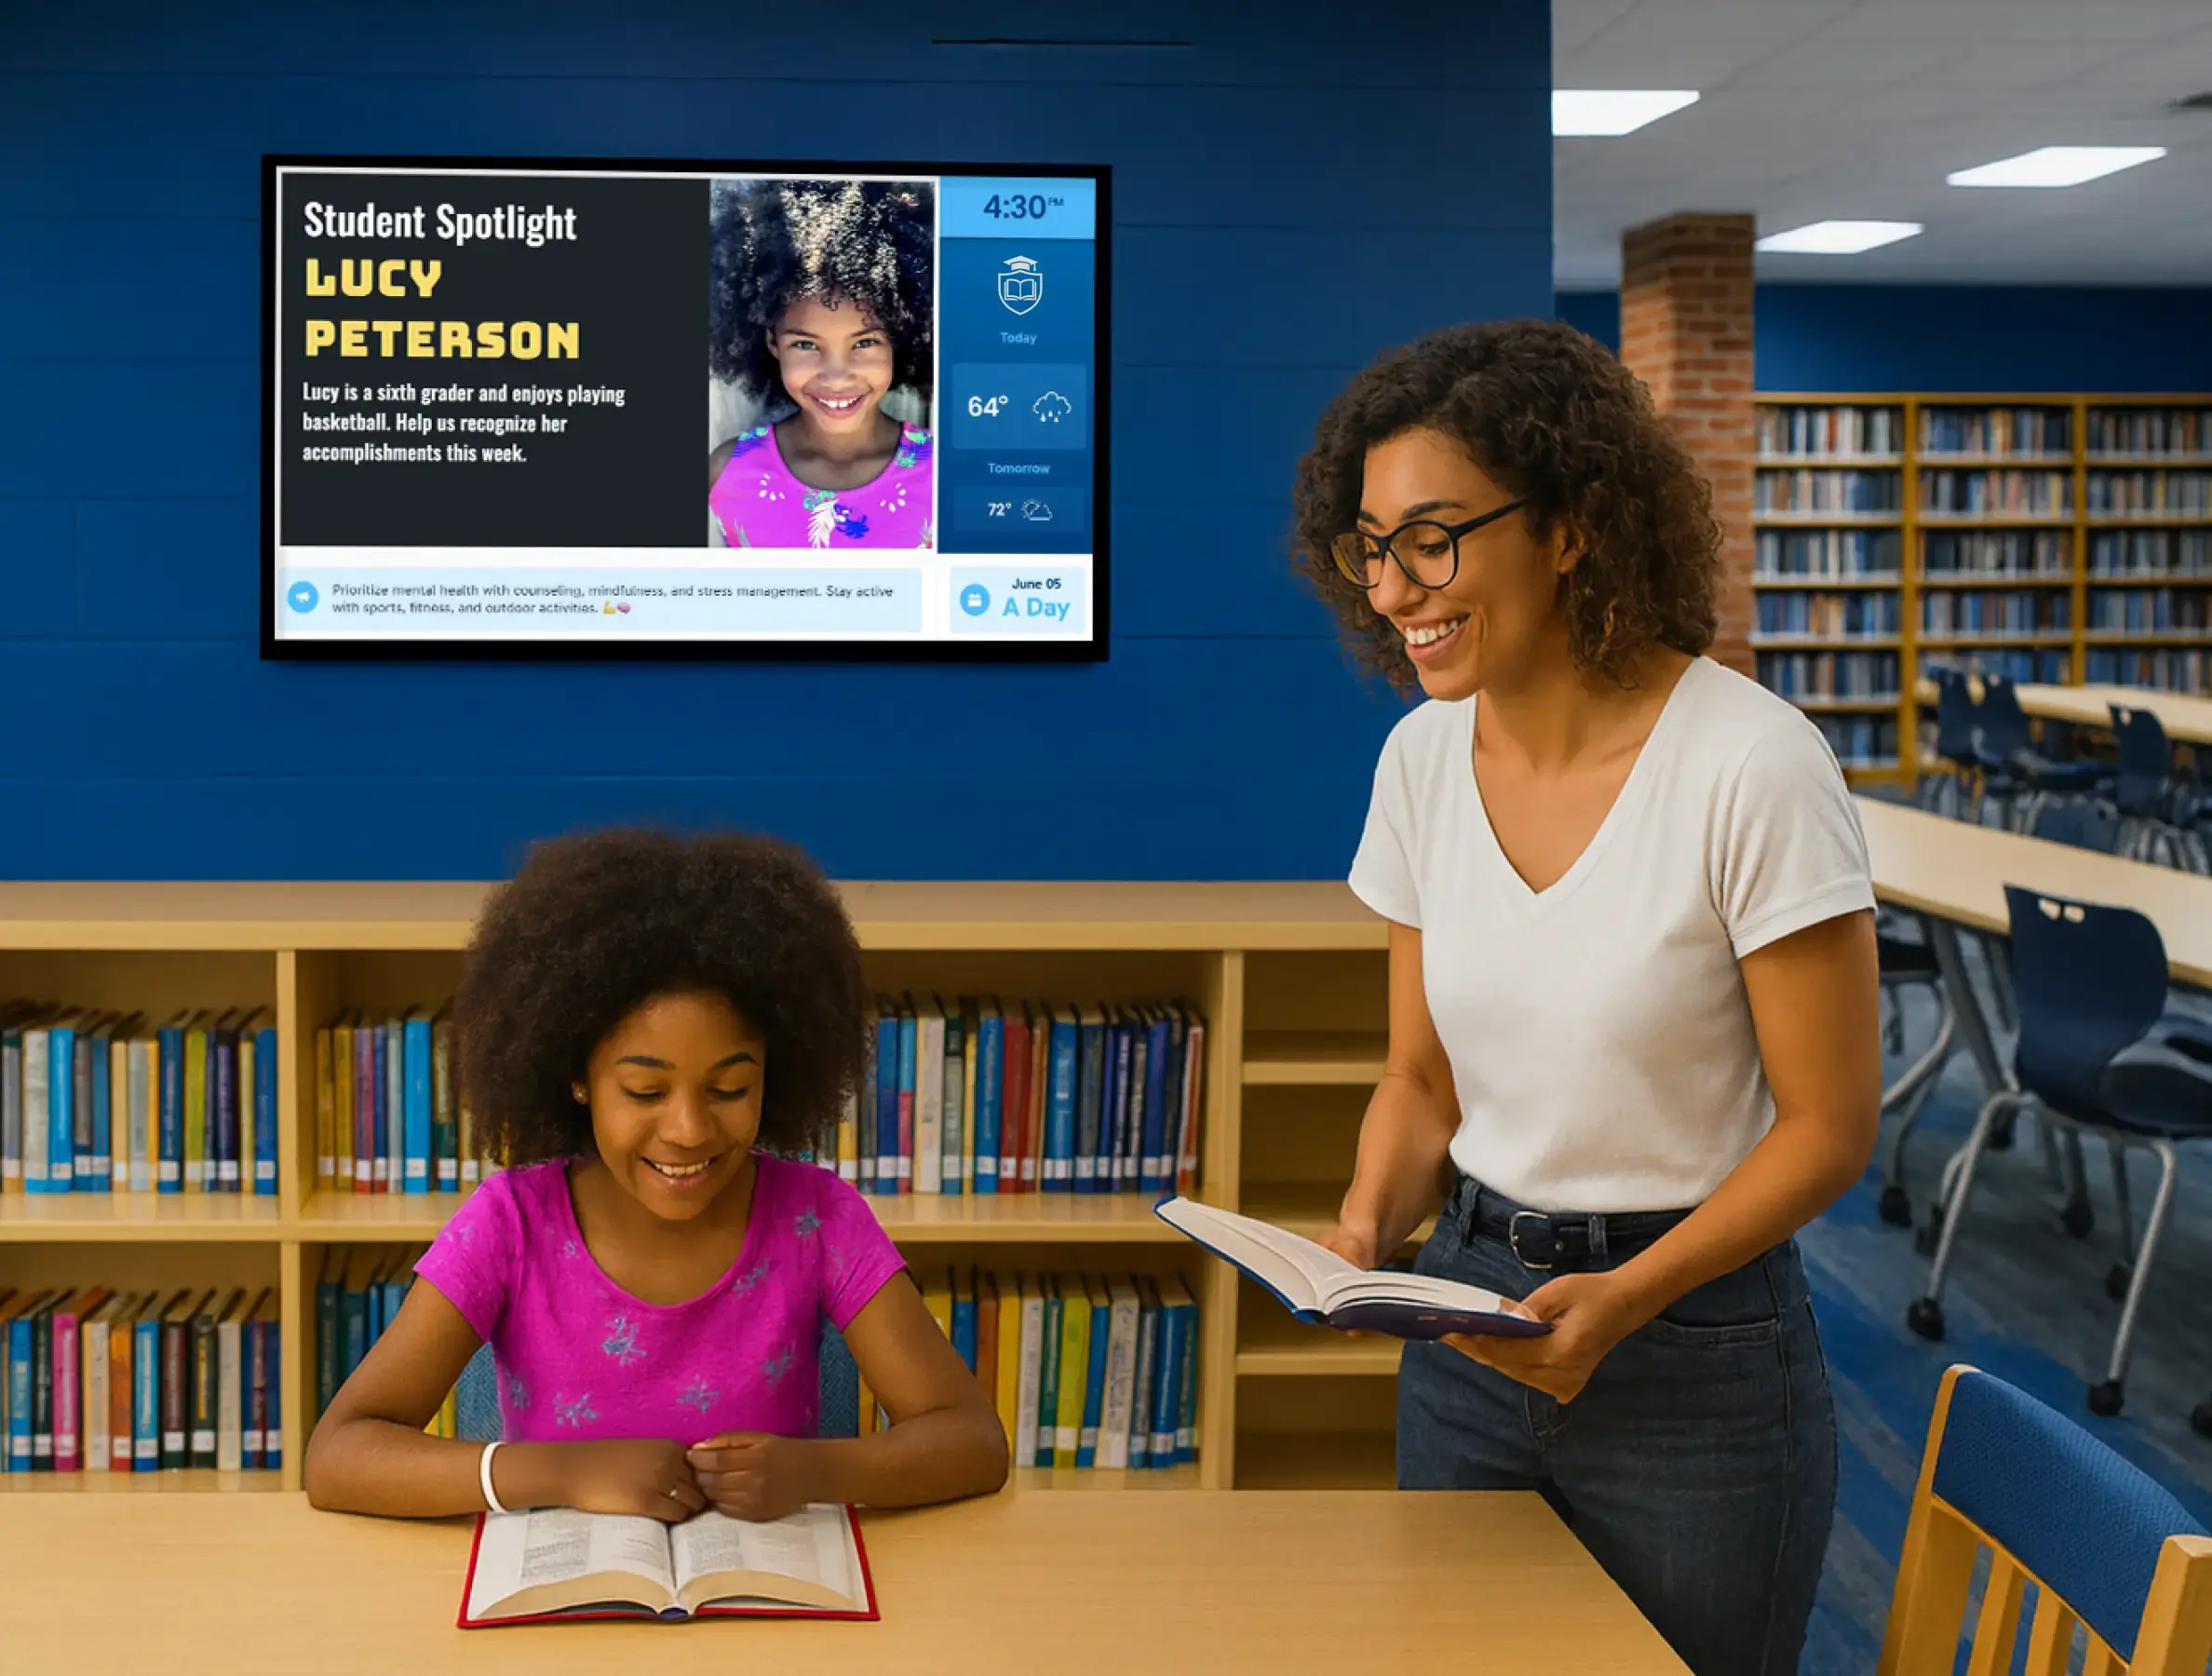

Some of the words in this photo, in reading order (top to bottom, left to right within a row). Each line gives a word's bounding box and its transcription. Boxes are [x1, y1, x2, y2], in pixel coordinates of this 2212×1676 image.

[983, 195, 1046, 219] 4:30
[303, 201, 425, 238] Student
[436, 203, 577, 248] Spotlight
[305, 258, 442, 298] LUCY
[305, 320, 580, 359] PETERSON
[1000, 331, 1037, 345] Today
[303, 382, 340, 403] Lucy
[344, 383, 358, 401] is
[362, 387, 372, 401] a
[377, 383, 416, 401] sixth
[421, 384, 474, 406] grader
[479, 384, 507, 402] and
[512, 385, 563, 406] enjoys
[567, 385, 626, 407] playing
[967, 394, 1008, 417] 64°
[303, 412, 391, 431] basketball.
[396, 412, 433, 435] Help
[437, 417, 455, 432] us
[460, 414, 537, 436] recognize
[542, 414, 568, 433] her
[303, 442, 442, 466] accomplishments
[447, 443, 478, 463] this
[481, 443, 528, 463] week.
[988, 463, 1051, 474] Tomorrow
[987, 502, 1012, 517] 72°
[332, 584, 389, 597] Prioritize
[392, 585, 436, 597] mental
[439, 585, 479, 597] health
[483, 585, 510, 597] with
[513, 585, 585, 599] counseling,
[588, 585, 667, 599] mindfulness,
[670, 586, 694, 597] and
[697, 587, 734, 597] stress
[736, 587, 822, 600] management.
[826, 586, 852, 600] Stay
[856, 586, 894, 598] active
[1012, 578, 1043, 590] June
[1045, 578, 1062, 589] 05
[332, 602, 359, 614] with
[363, 603, 406, 615] sports,
[409, 602, 454, 615] fitness,
[458, 602, 481, 614] and
[484, 603, 535, 614] outdoor
[538, 603, 599, 614] activities.
[1003, 597, 1020, 617] A
[1026, 597, 1071, 622] Day
